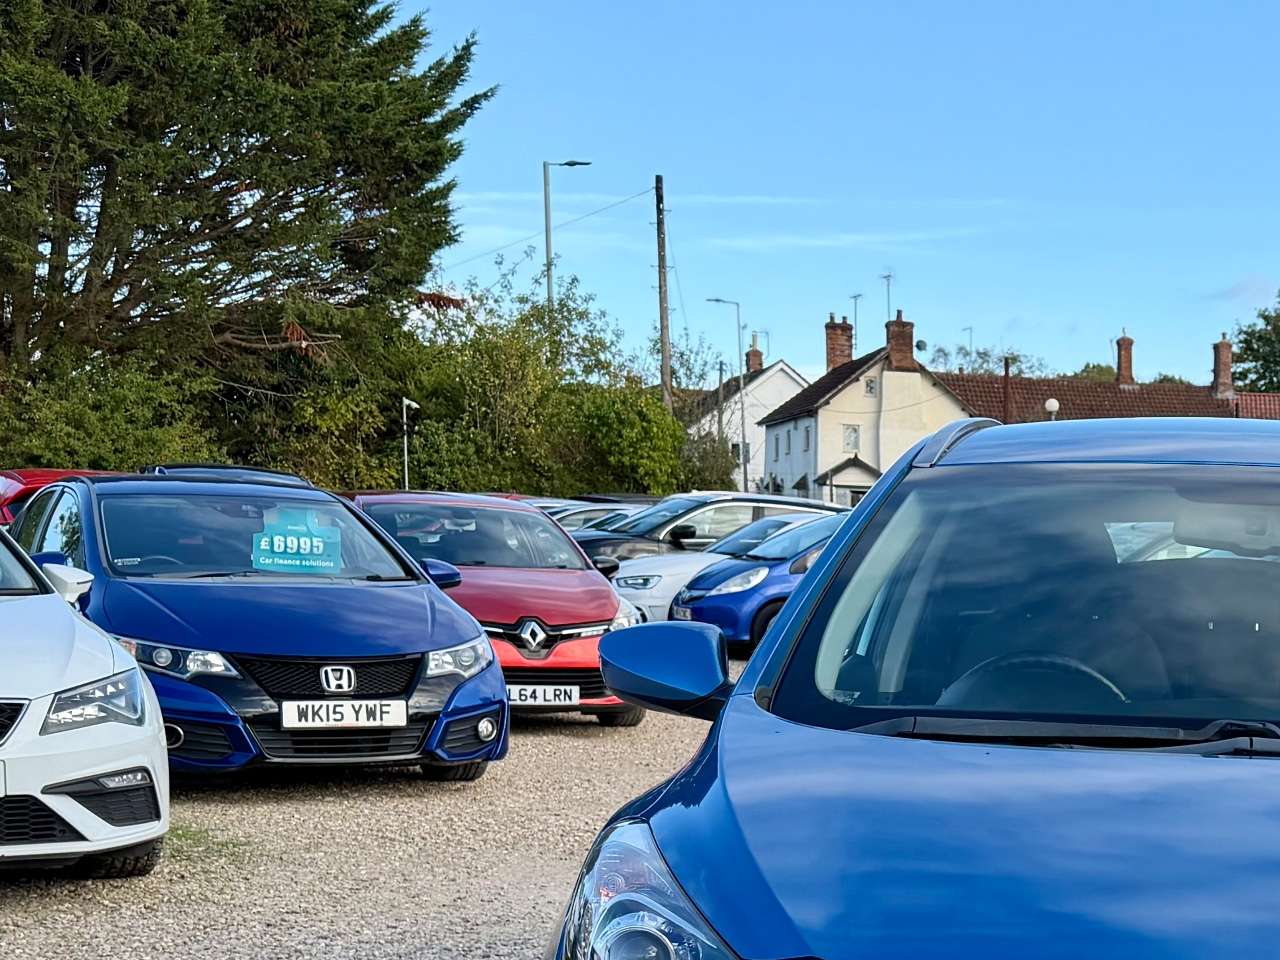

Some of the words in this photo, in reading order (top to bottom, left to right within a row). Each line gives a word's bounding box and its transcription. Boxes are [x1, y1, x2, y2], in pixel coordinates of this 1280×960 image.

[260, 556, 274, 564] Car
[274, 557, 300, 566] finance
[302, 558, 334, 568] solutions
[508, 687, 538, 702] L64
[543, 687, 573, 702] LRN
[297, 704, 344, 722] WK15
[351, 703, 391, 722] YWF
